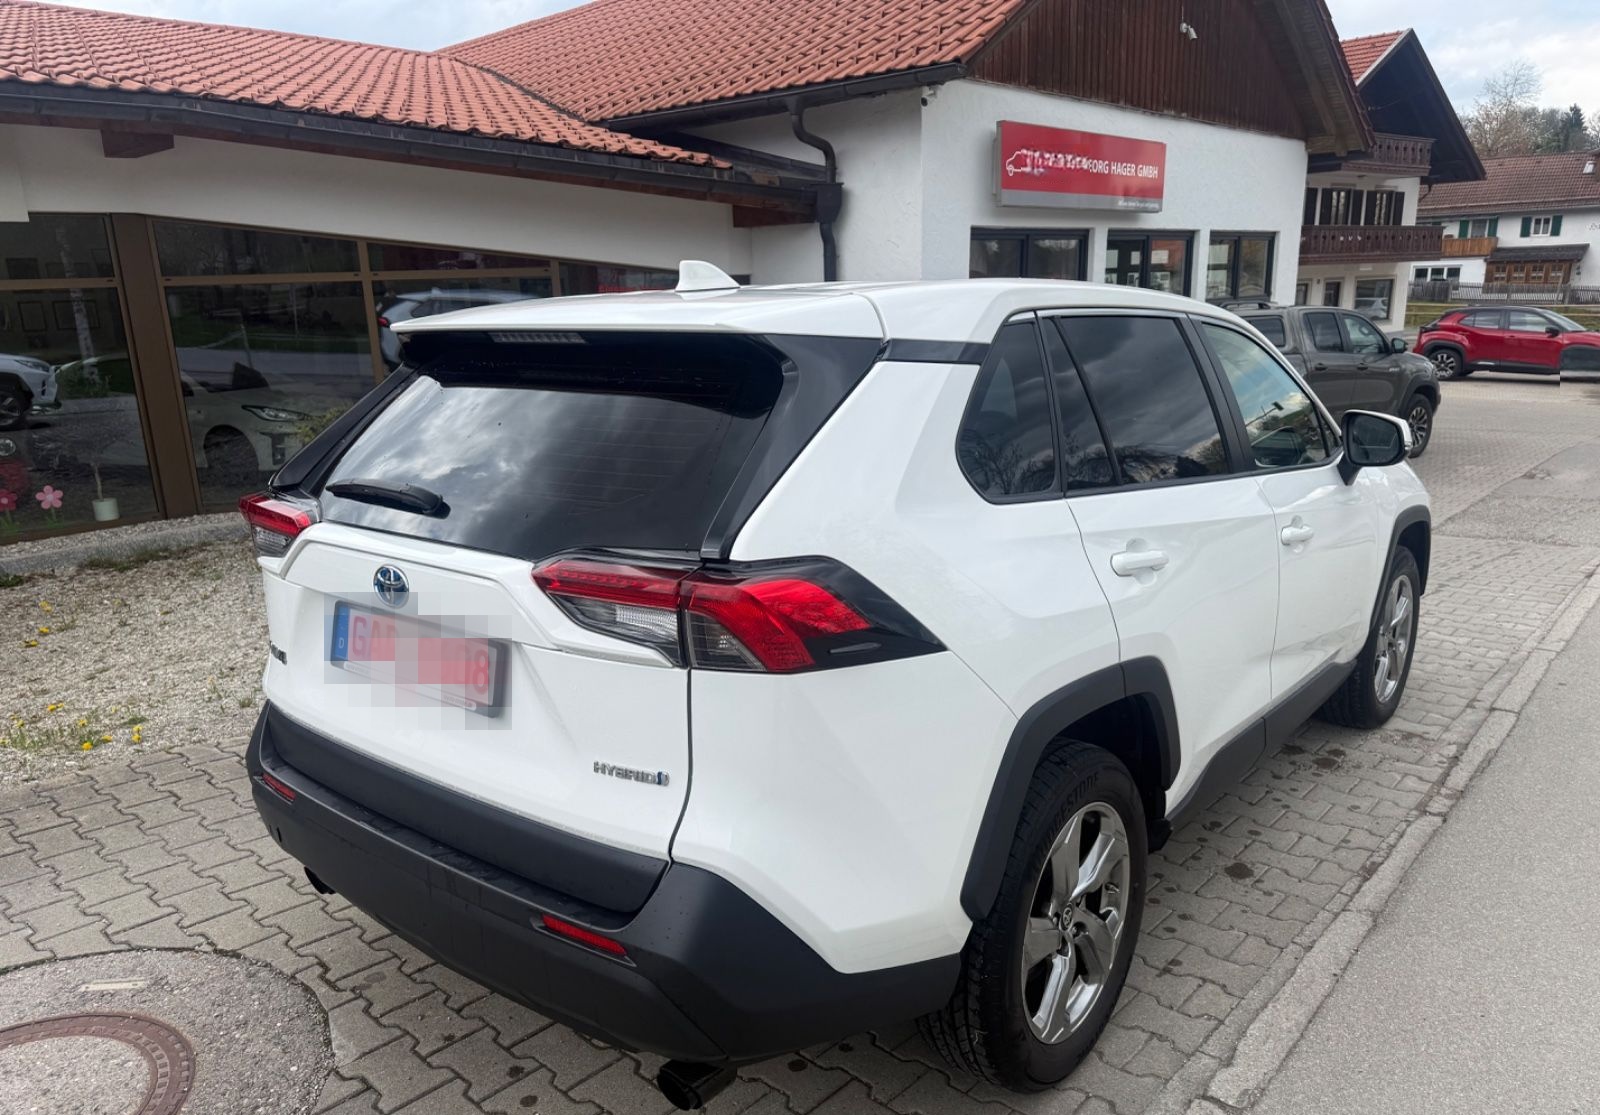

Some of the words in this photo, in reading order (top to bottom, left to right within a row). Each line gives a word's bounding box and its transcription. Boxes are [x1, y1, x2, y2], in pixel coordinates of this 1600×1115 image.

[1110, 162, 1136, 177] HAGER
[1137, 165, 1159, 178] GMBH
[593, 761, 657, 785] HYBRID
